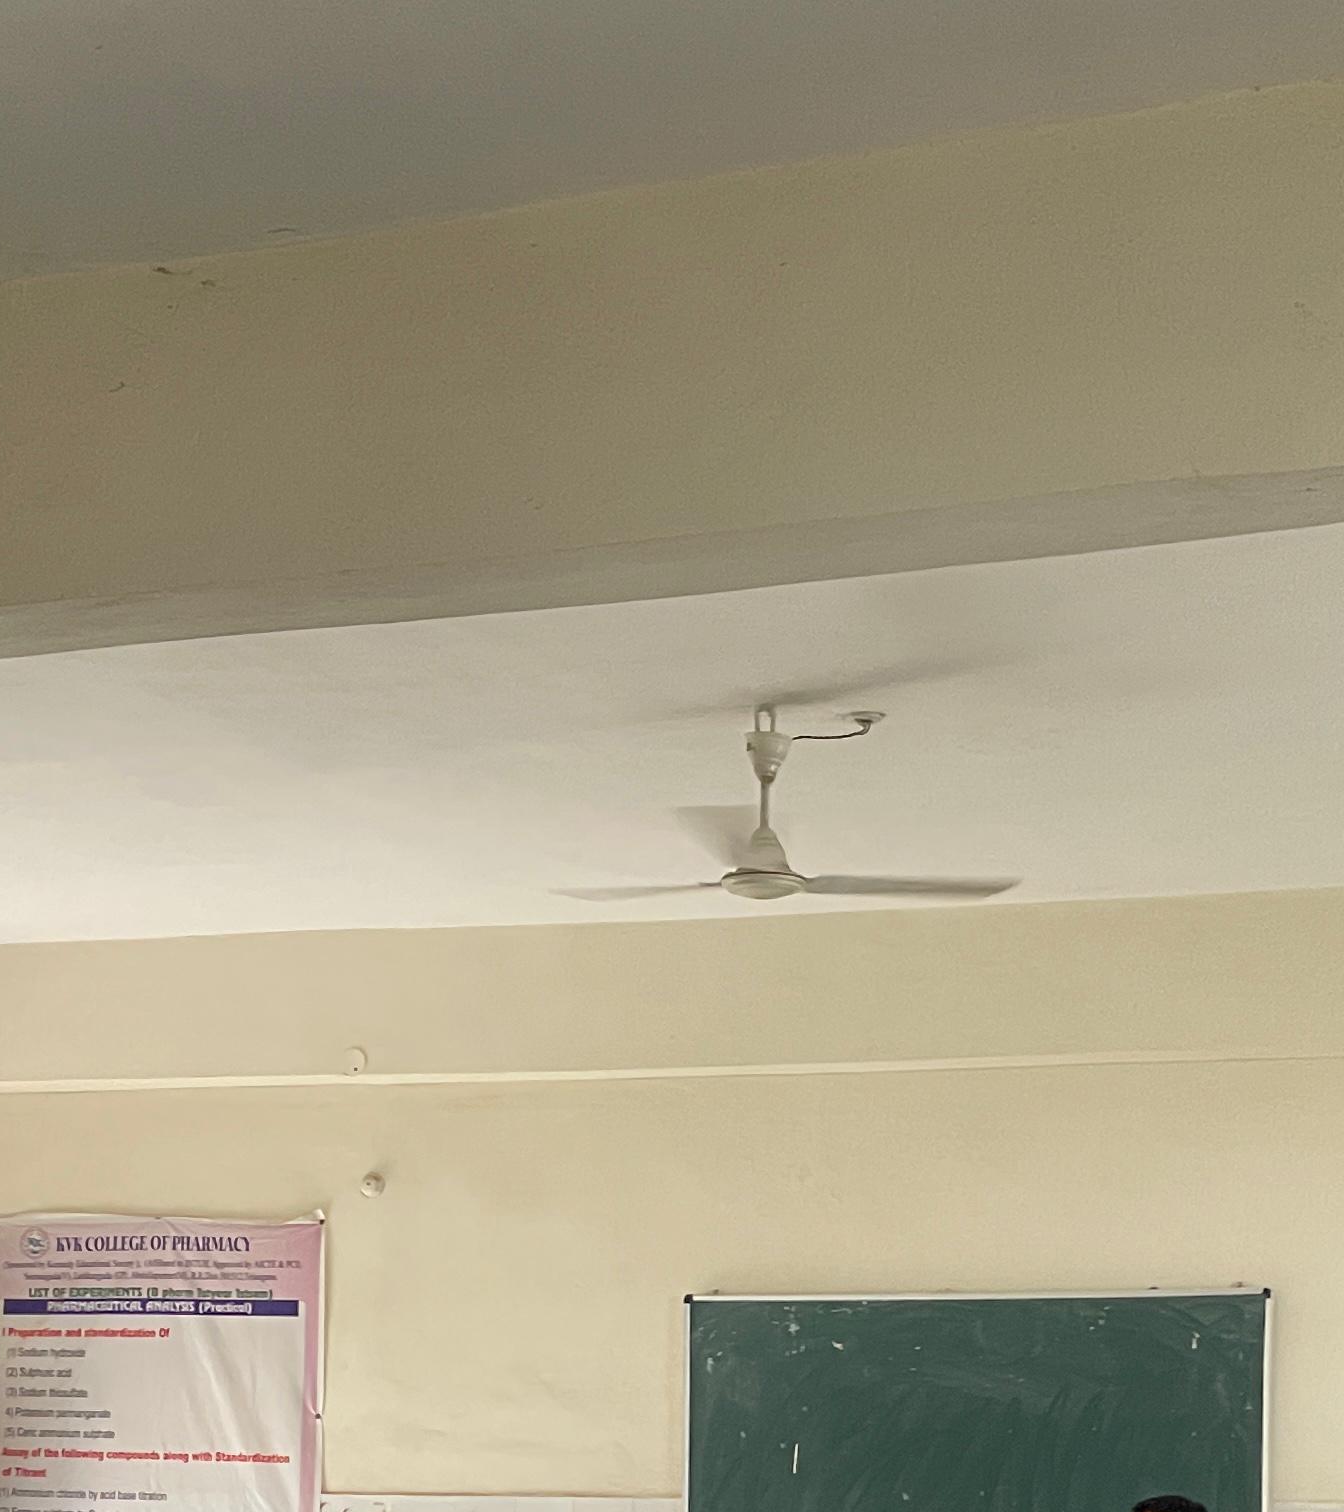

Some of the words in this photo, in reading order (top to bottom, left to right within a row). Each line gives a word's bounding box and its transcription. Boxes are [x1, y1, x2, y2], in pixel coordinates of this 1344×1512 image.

[56, 1236, 83, 1252] KVK
[85, 1235, 148, 1252] COLLEGE
[150, 1235, 170, 1251] OF
[172, 1235, 251, 1252] PHARMACY
[28, 1287, 50, 1298] LIST
[52, 1287, 67, 1298] OF
[46, 1300, 143, 1312] PHARMACEUTICAL
[145, 1301, 195, 1312] ANALYSIS
[31, 1447, 42, 1458] of
[44, 1448, 59, 1458] the
[61, 1448, 104, 1461] following
[163, 1451, 189, 1464] along
[192, 1451, 213, 1462] with
[215, 1451, 290, 1464] Standardization
[88, 1490, 98, 1502] by
